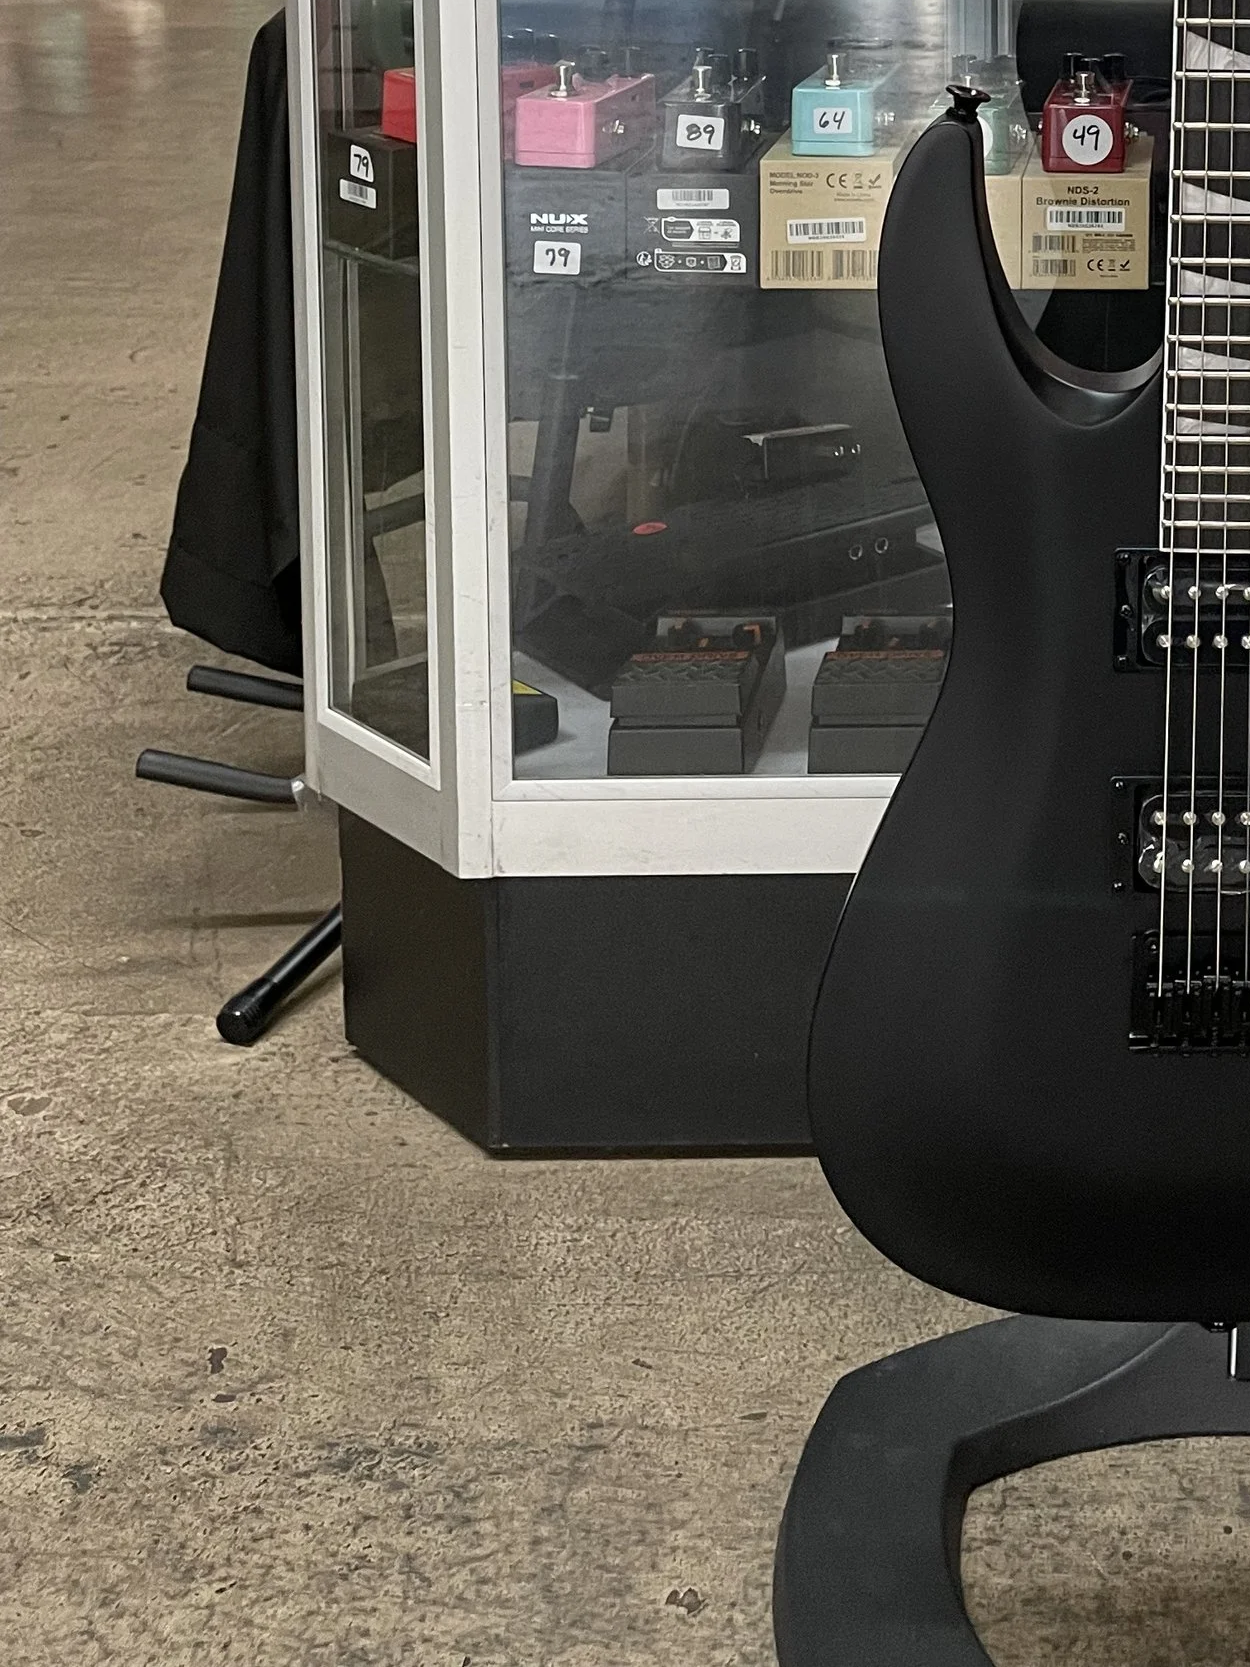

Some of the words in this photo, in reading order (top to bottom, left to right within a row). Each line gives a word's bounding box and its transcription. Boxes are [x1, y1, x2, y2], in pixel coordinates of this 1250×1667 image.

[818, 110, 846, 130] 64
[685, 123, 715, 145] 89
[1072, 124, 1100, 151] 49
[353, 153, 369, 178] 79
[1067, 186, 1099, 195] NDS-2
[1036, 197, 1077, 206] Brownie
[1080, 196, 1130, 206] Distortion
[530, 213, 588, 225] NUX
[545, 247, 571, 267] 79
